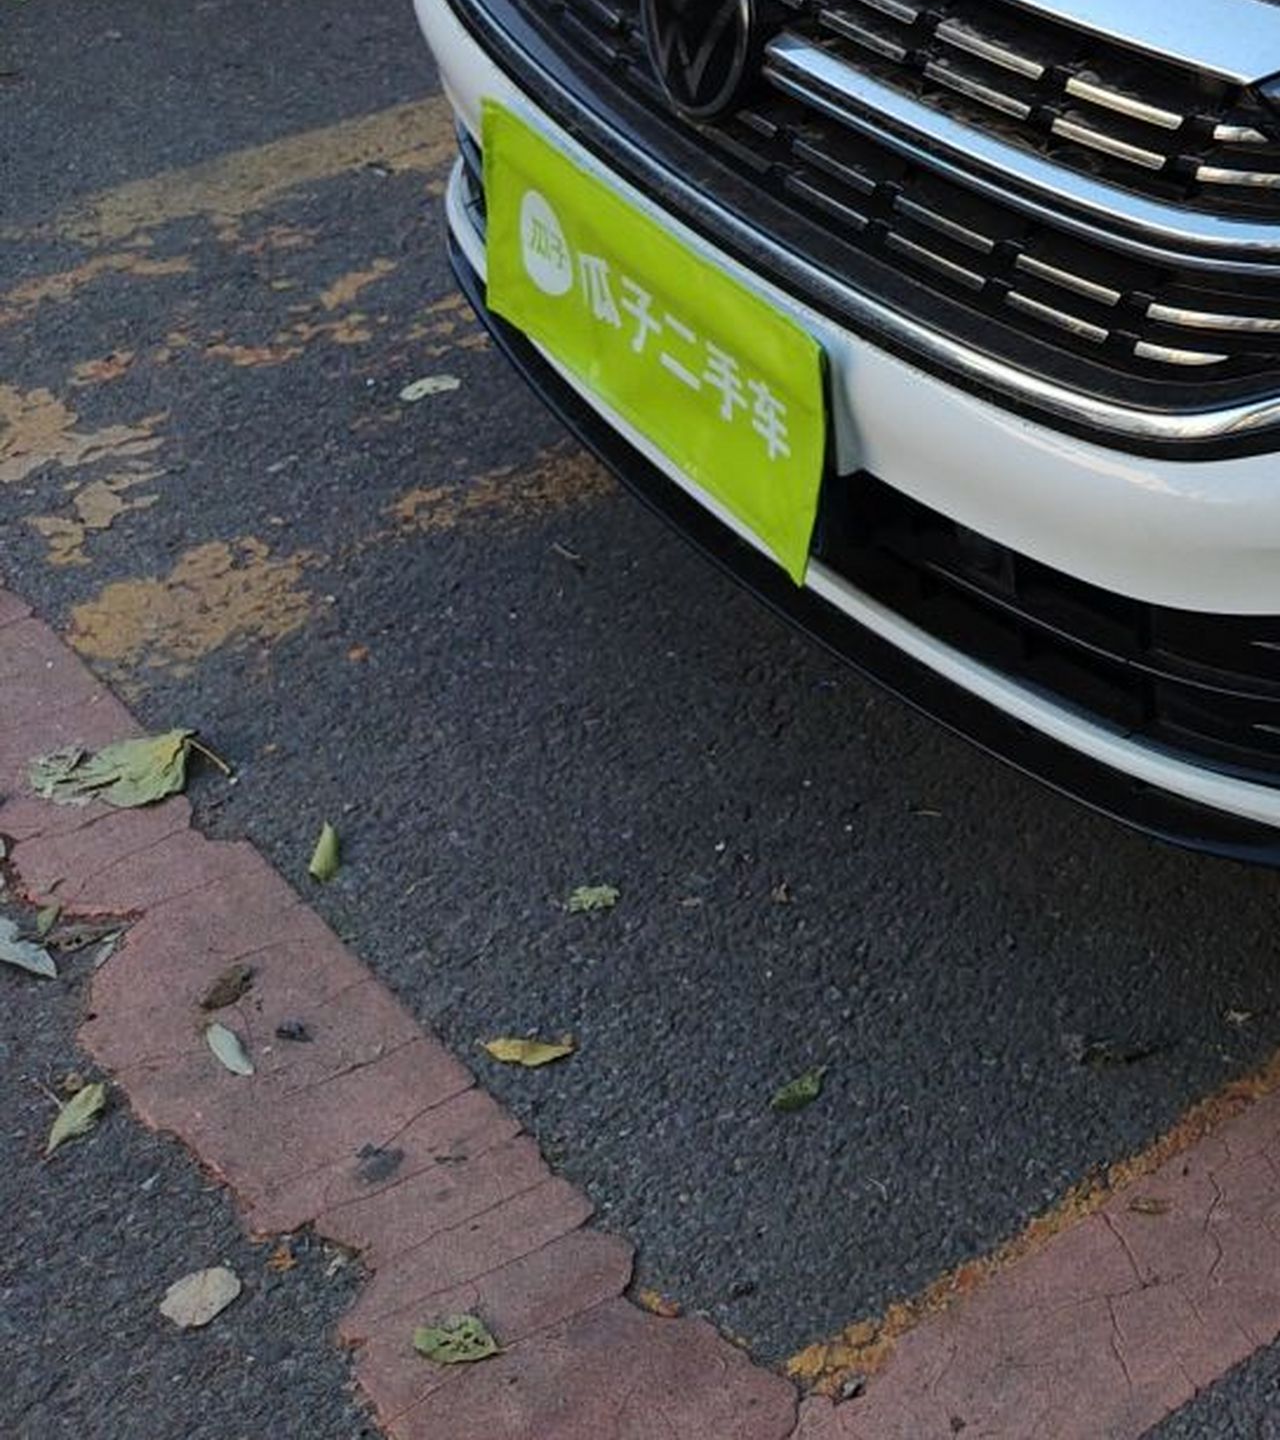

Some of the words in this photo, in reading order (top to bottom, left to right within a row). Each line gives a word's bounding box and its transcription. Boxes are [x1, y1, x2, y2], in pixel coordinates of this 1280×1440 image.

[578, 251, 792, 461] 瓜子二手车
